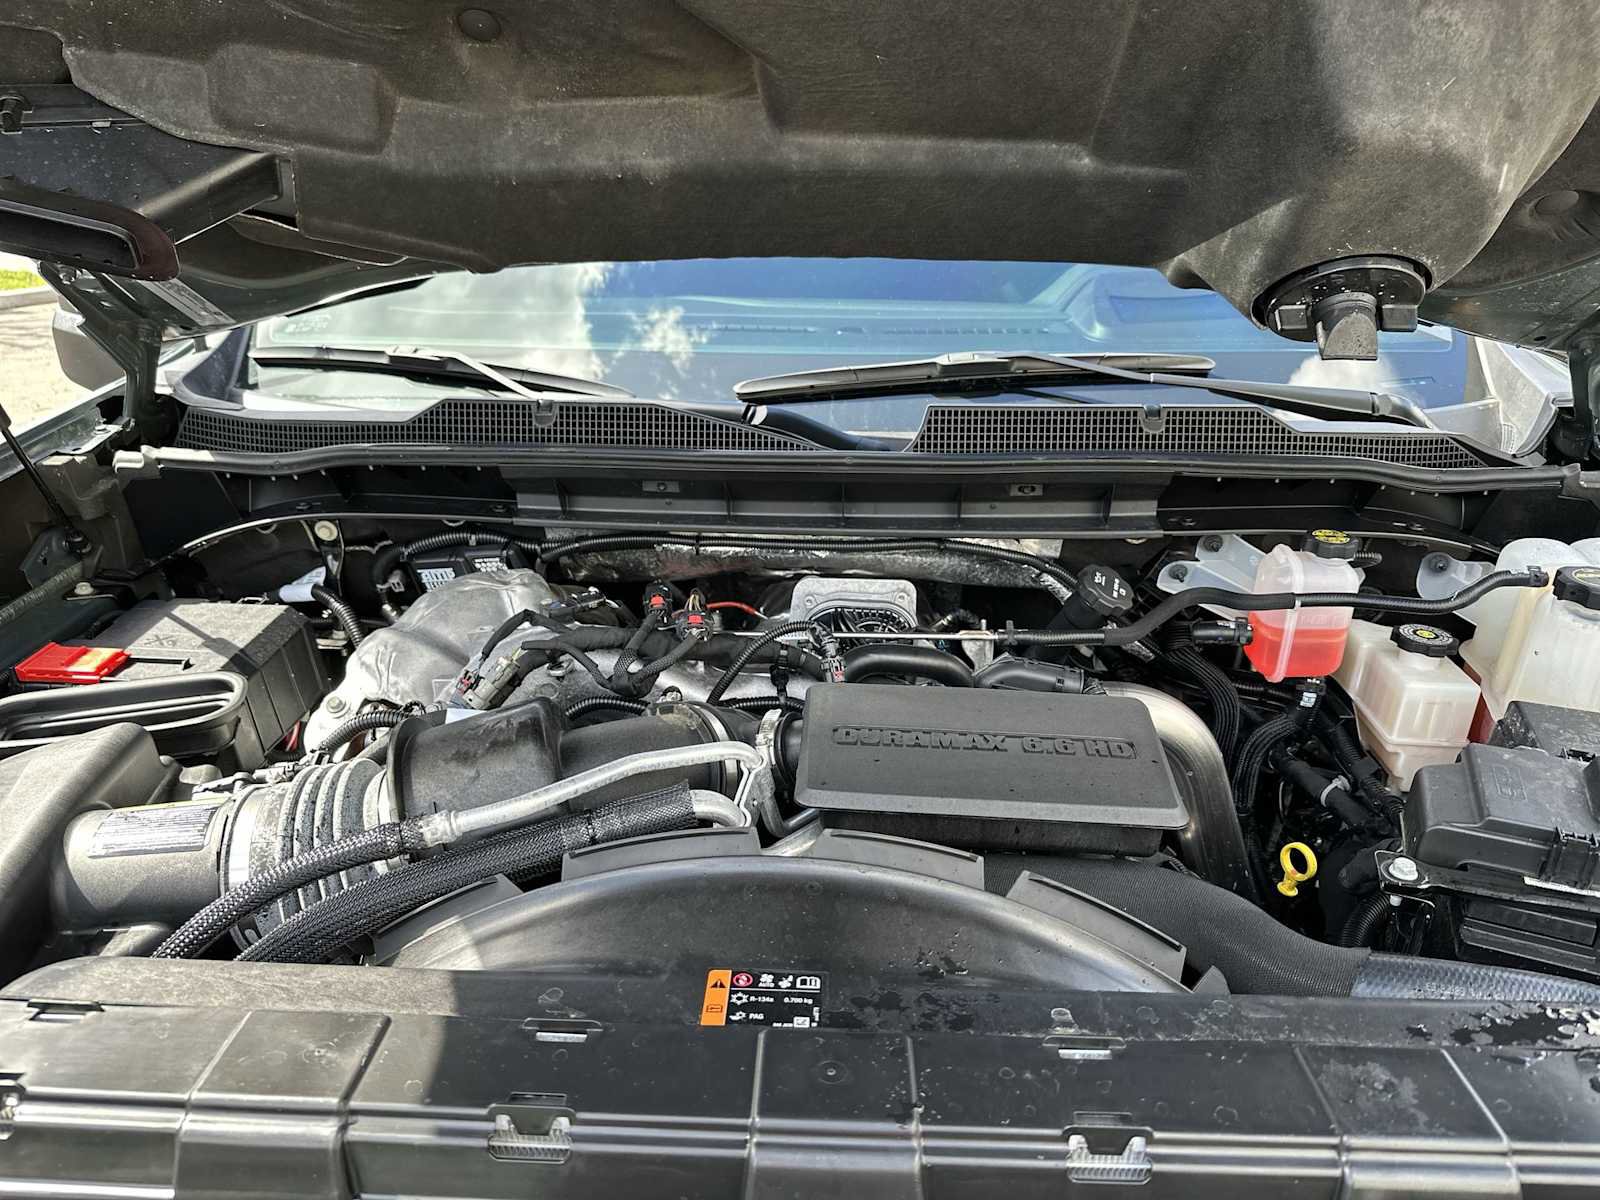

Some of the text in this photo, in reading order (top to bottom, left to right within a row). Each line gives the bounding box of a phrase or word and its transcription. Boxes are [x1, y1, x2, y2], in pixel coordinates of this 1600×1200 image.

[833, 727, 1137, 759] DURAMAX 6.6 HD
